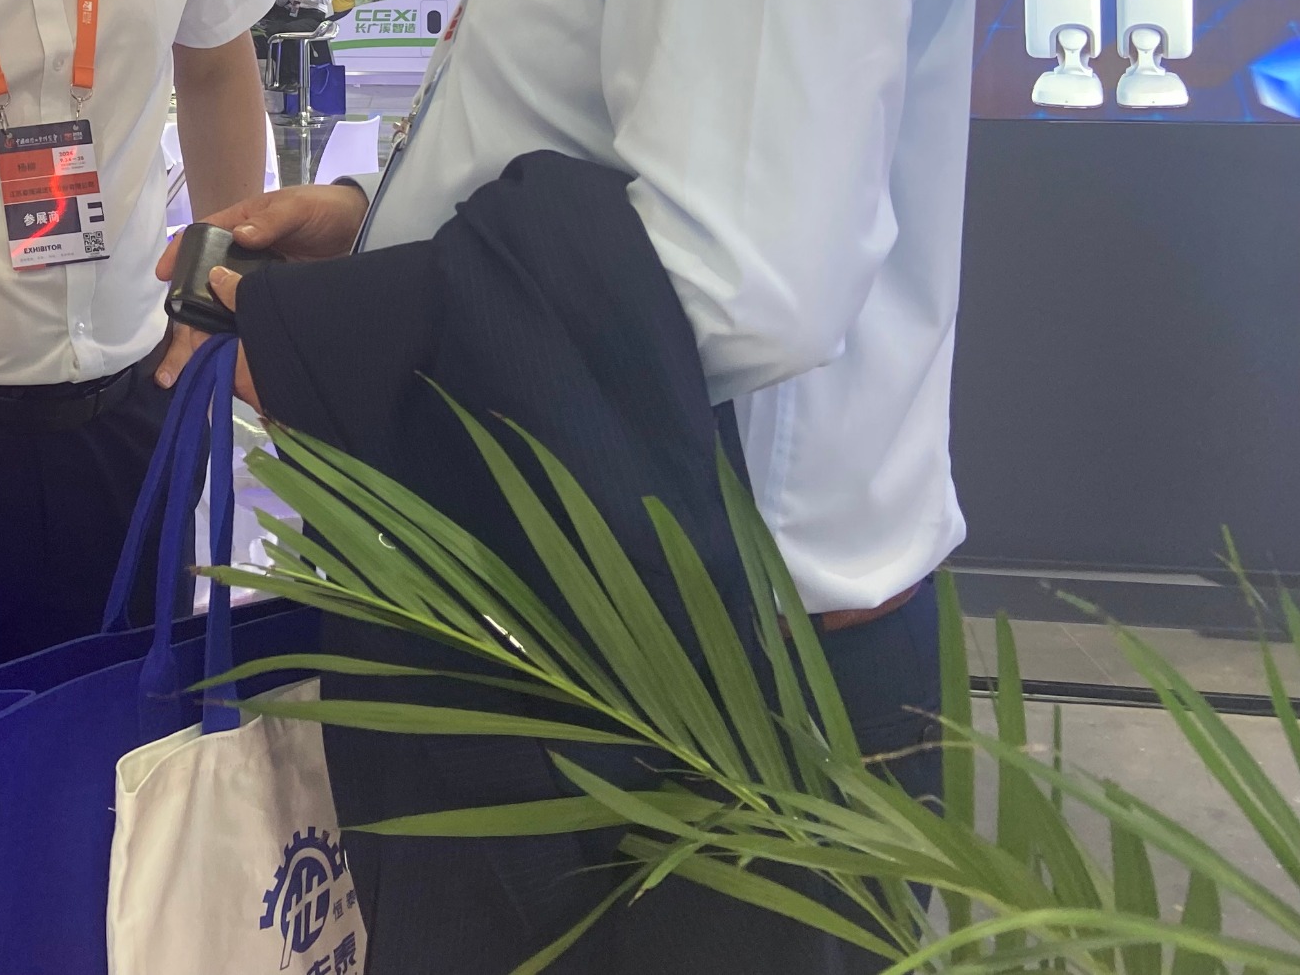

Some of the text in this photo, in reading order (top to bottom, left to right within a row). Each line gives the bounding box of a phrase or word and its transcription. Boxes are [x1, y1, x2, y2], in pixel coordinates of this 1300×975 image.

[355, 23, 416, 34] 长广溪智造
[23, 211, 60, 227] 参展商
[24, 244, 62, 254] EXHIBITOR
